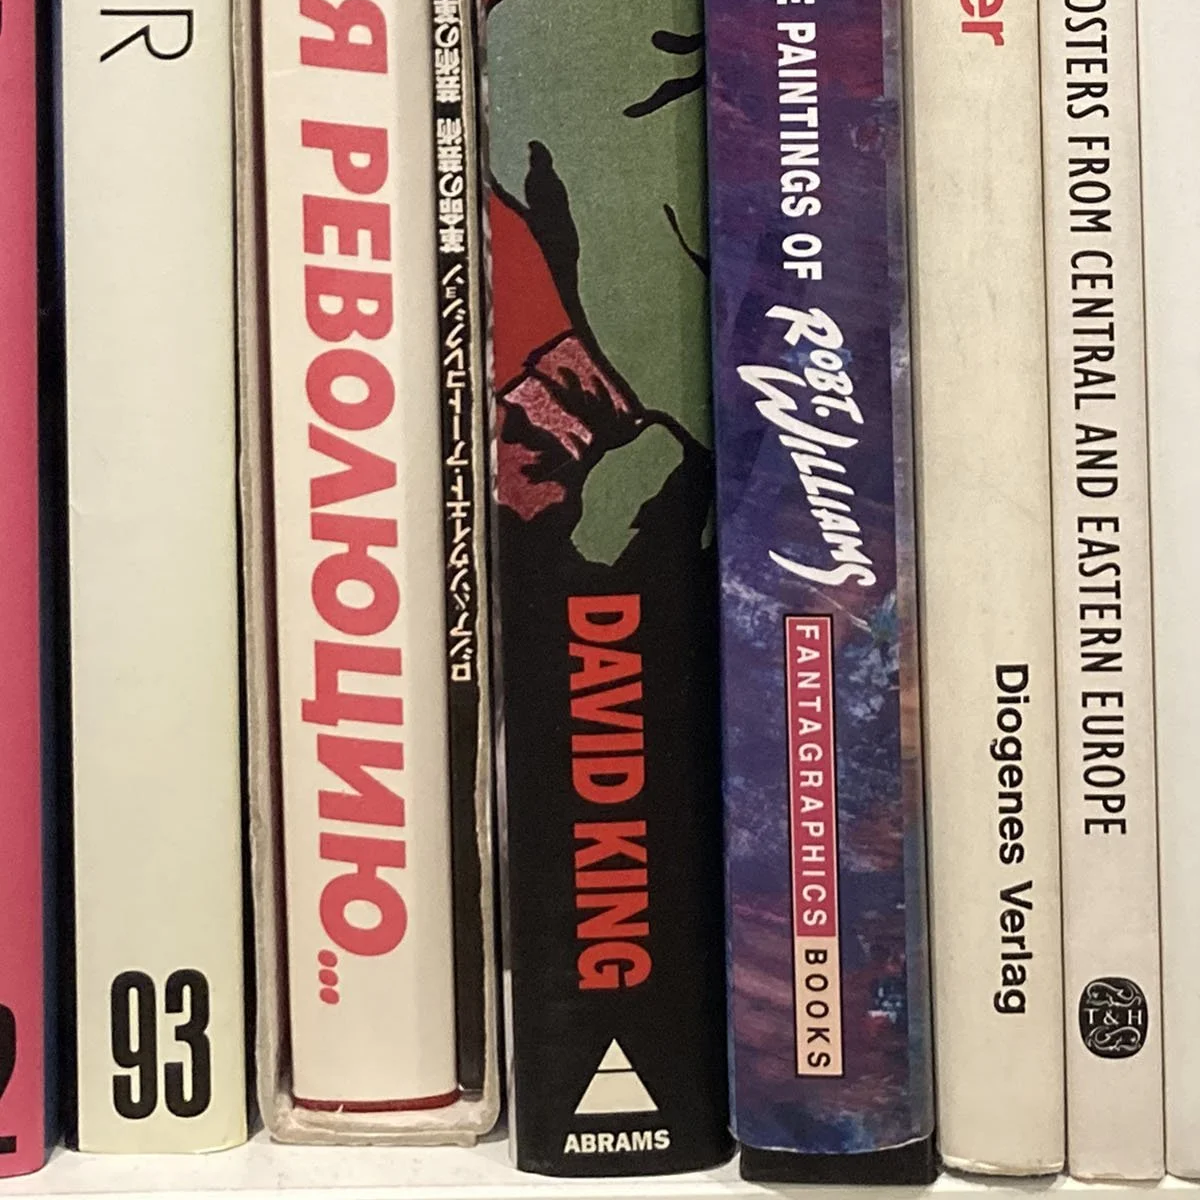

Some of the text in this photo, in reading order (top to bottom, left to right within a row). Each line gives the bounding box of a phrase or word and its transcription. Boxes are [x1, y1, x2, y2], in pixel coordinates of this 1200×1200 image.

[777, 22, 821, 217] PAINTINGS
[1068, 137, 1111, 232] FROM
[782, 234, 822, 280] OF
[1071, 250, 1116, 405] CENTRAL
[736, 364, 877, 586] WILLIAMS
[1076, 424, 1118, 498] AND
[1078, 517, 1122, 672] EASTERN
[568, 594, 651, 989] DAVID KING
[990, 665, 1033, 1014] Diogenes Verlag
[1082, 692, 1126, 834] EUROPE
[796, 624, 832, 1068] FANTAGRAPHICS BOOKS
[111, 969, 211, 1119] 93
[564, 1130, 670, 1153] ABRAMS
